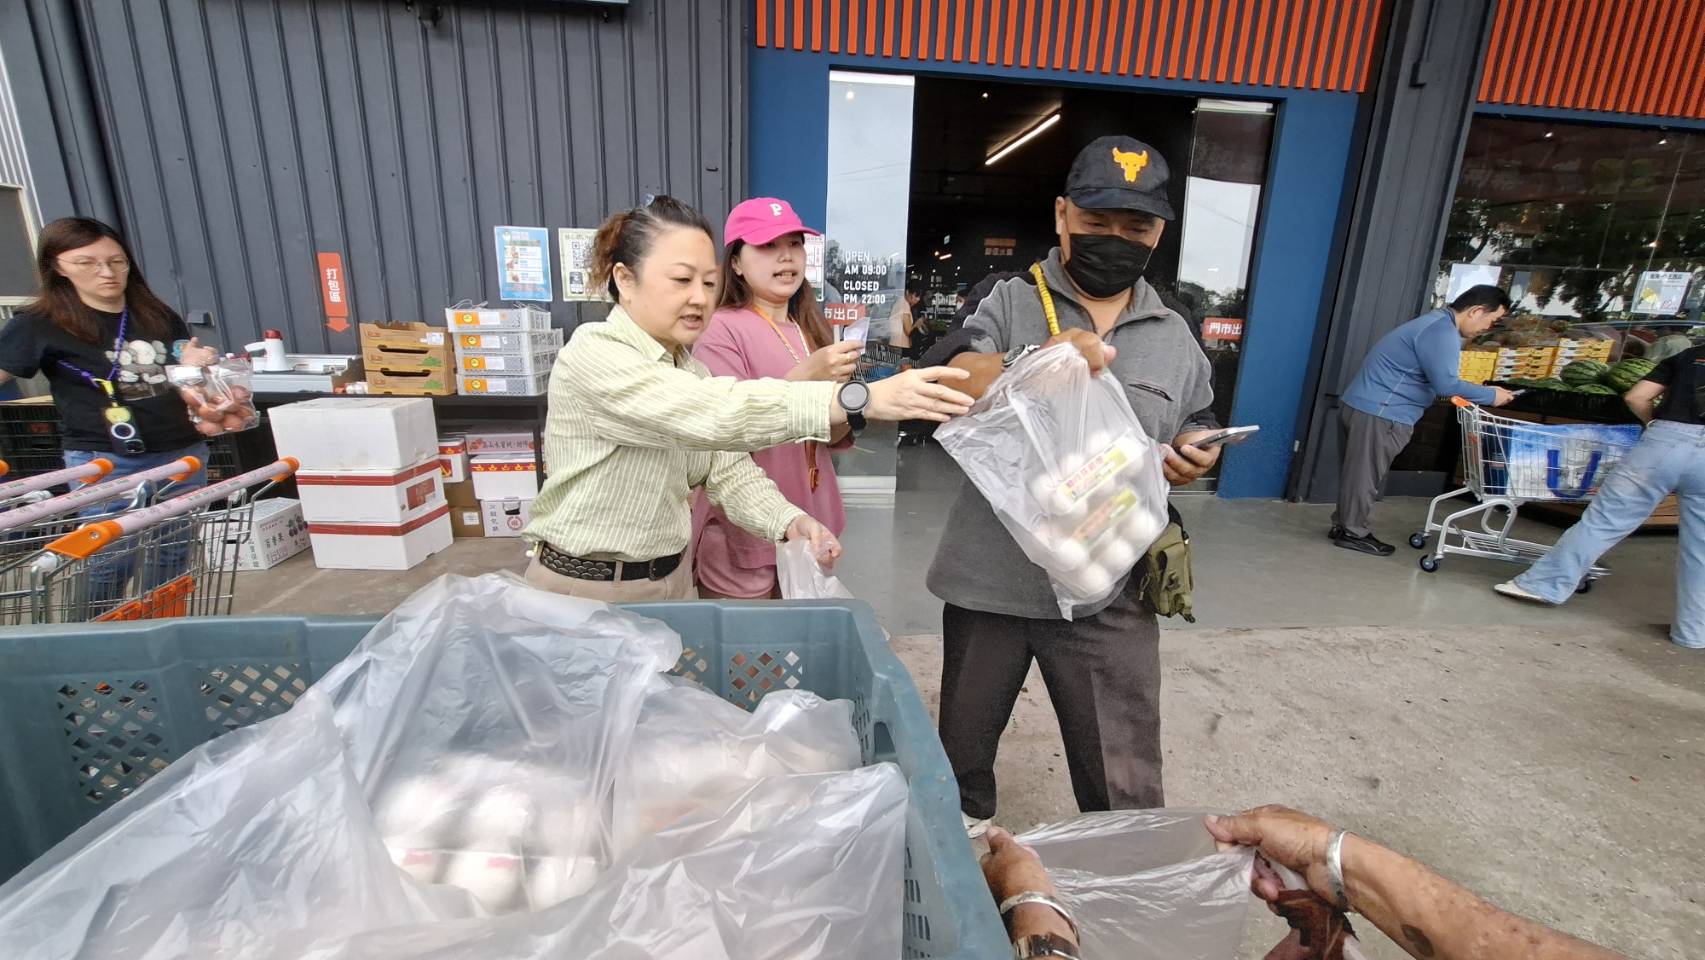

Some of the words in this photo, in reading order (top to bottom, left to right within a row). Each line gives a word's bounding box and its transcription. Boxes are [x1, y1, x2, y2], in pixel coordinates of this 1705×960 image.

[769, 203, 783, 216] P
[845, 251, 870, 262] OPEN
[844, 265, 859, 275] AM
[862, 265, 887, 275] 09:00
[326, 267, 341, 303] 打包區
[843, 281, 879, 291] CLOSED
[843, 294, 857, 304] PM
[861, 294, 886, 304] 22:00
[1209, 322, 1242, 335] 門市出
